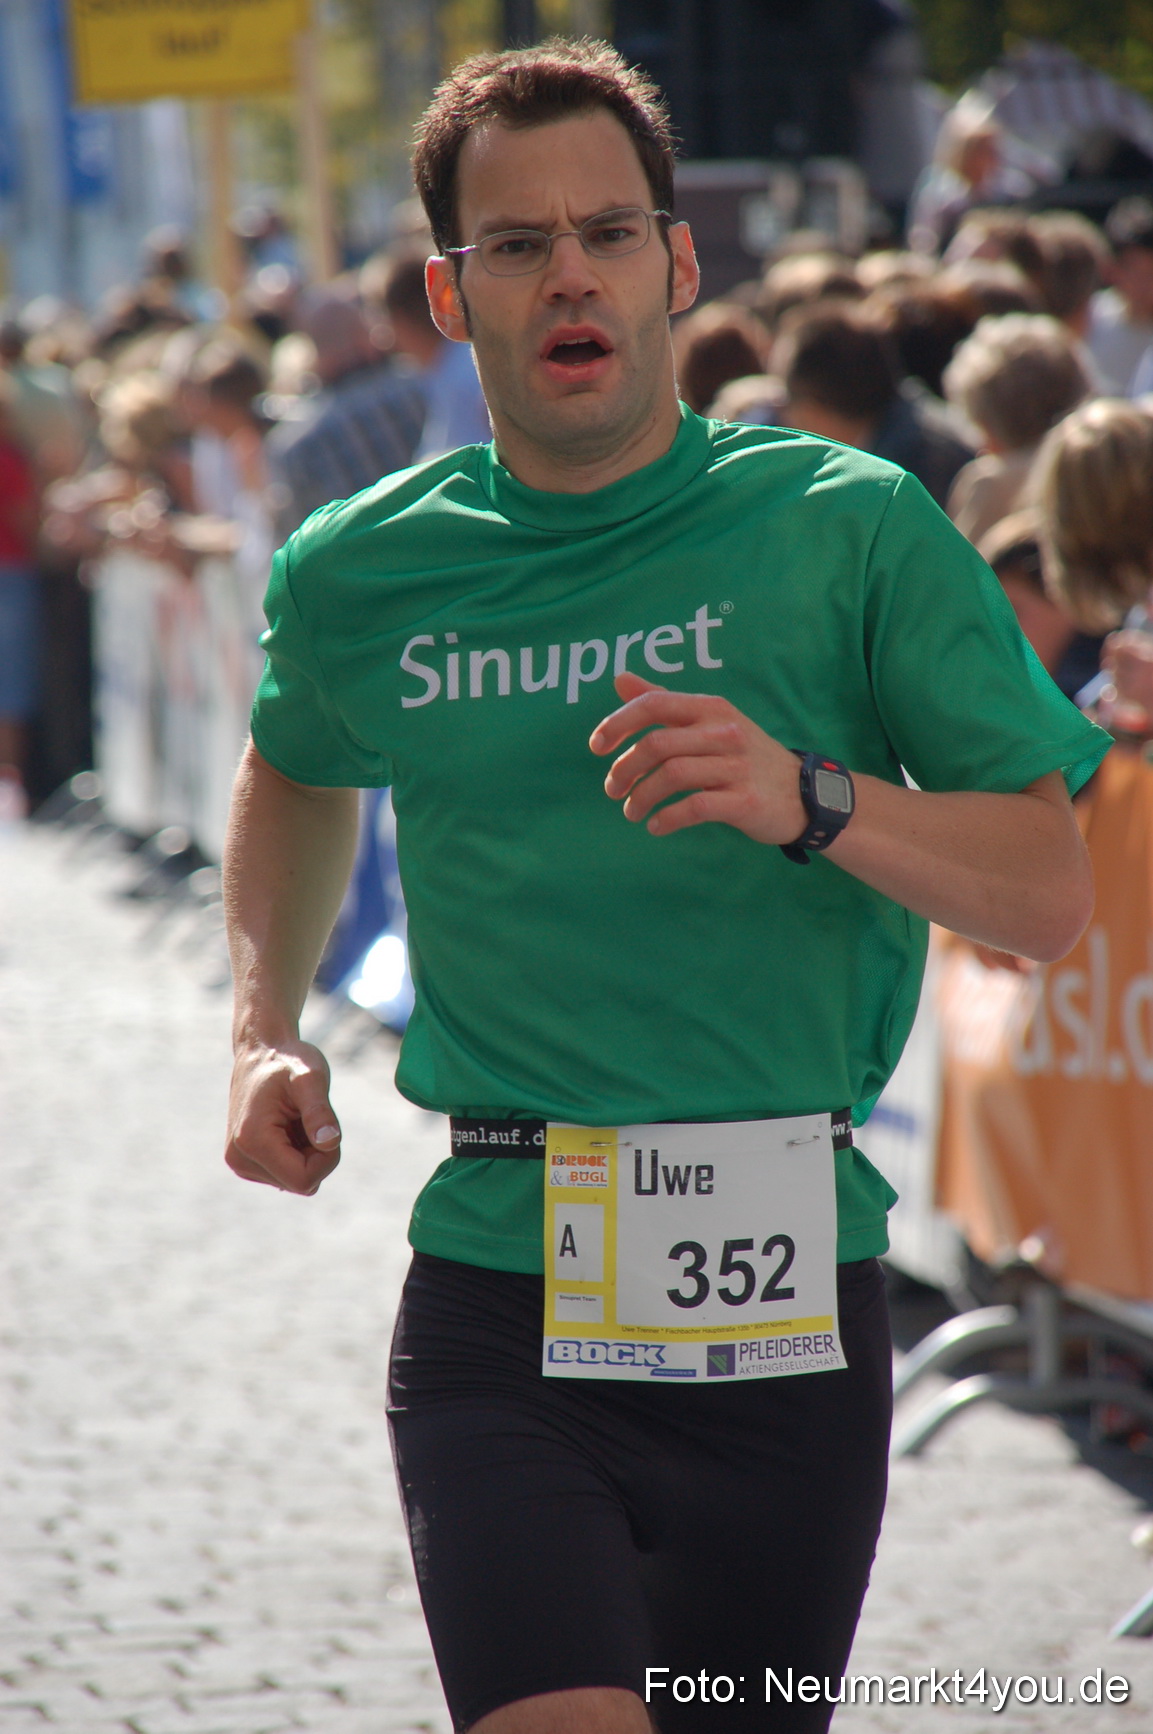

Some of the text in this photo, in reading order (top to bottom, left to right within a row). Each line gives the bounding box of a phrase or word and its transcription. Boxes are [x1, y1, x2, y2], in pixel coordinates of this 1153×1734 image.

[570, 1171, 608, 1183] BÖGL
[634, 1149, 714, 1196] Uwe
[559, 1224, 578, 1258] A
[666, 1234, 796, 1309] 352
[548, 1340, 666, 1368] BOCK
[739, 1334, 837, 1362] PFLEIDERER
[739, 1356, 841, 1376] AKTIENGESELLSCHAFT
